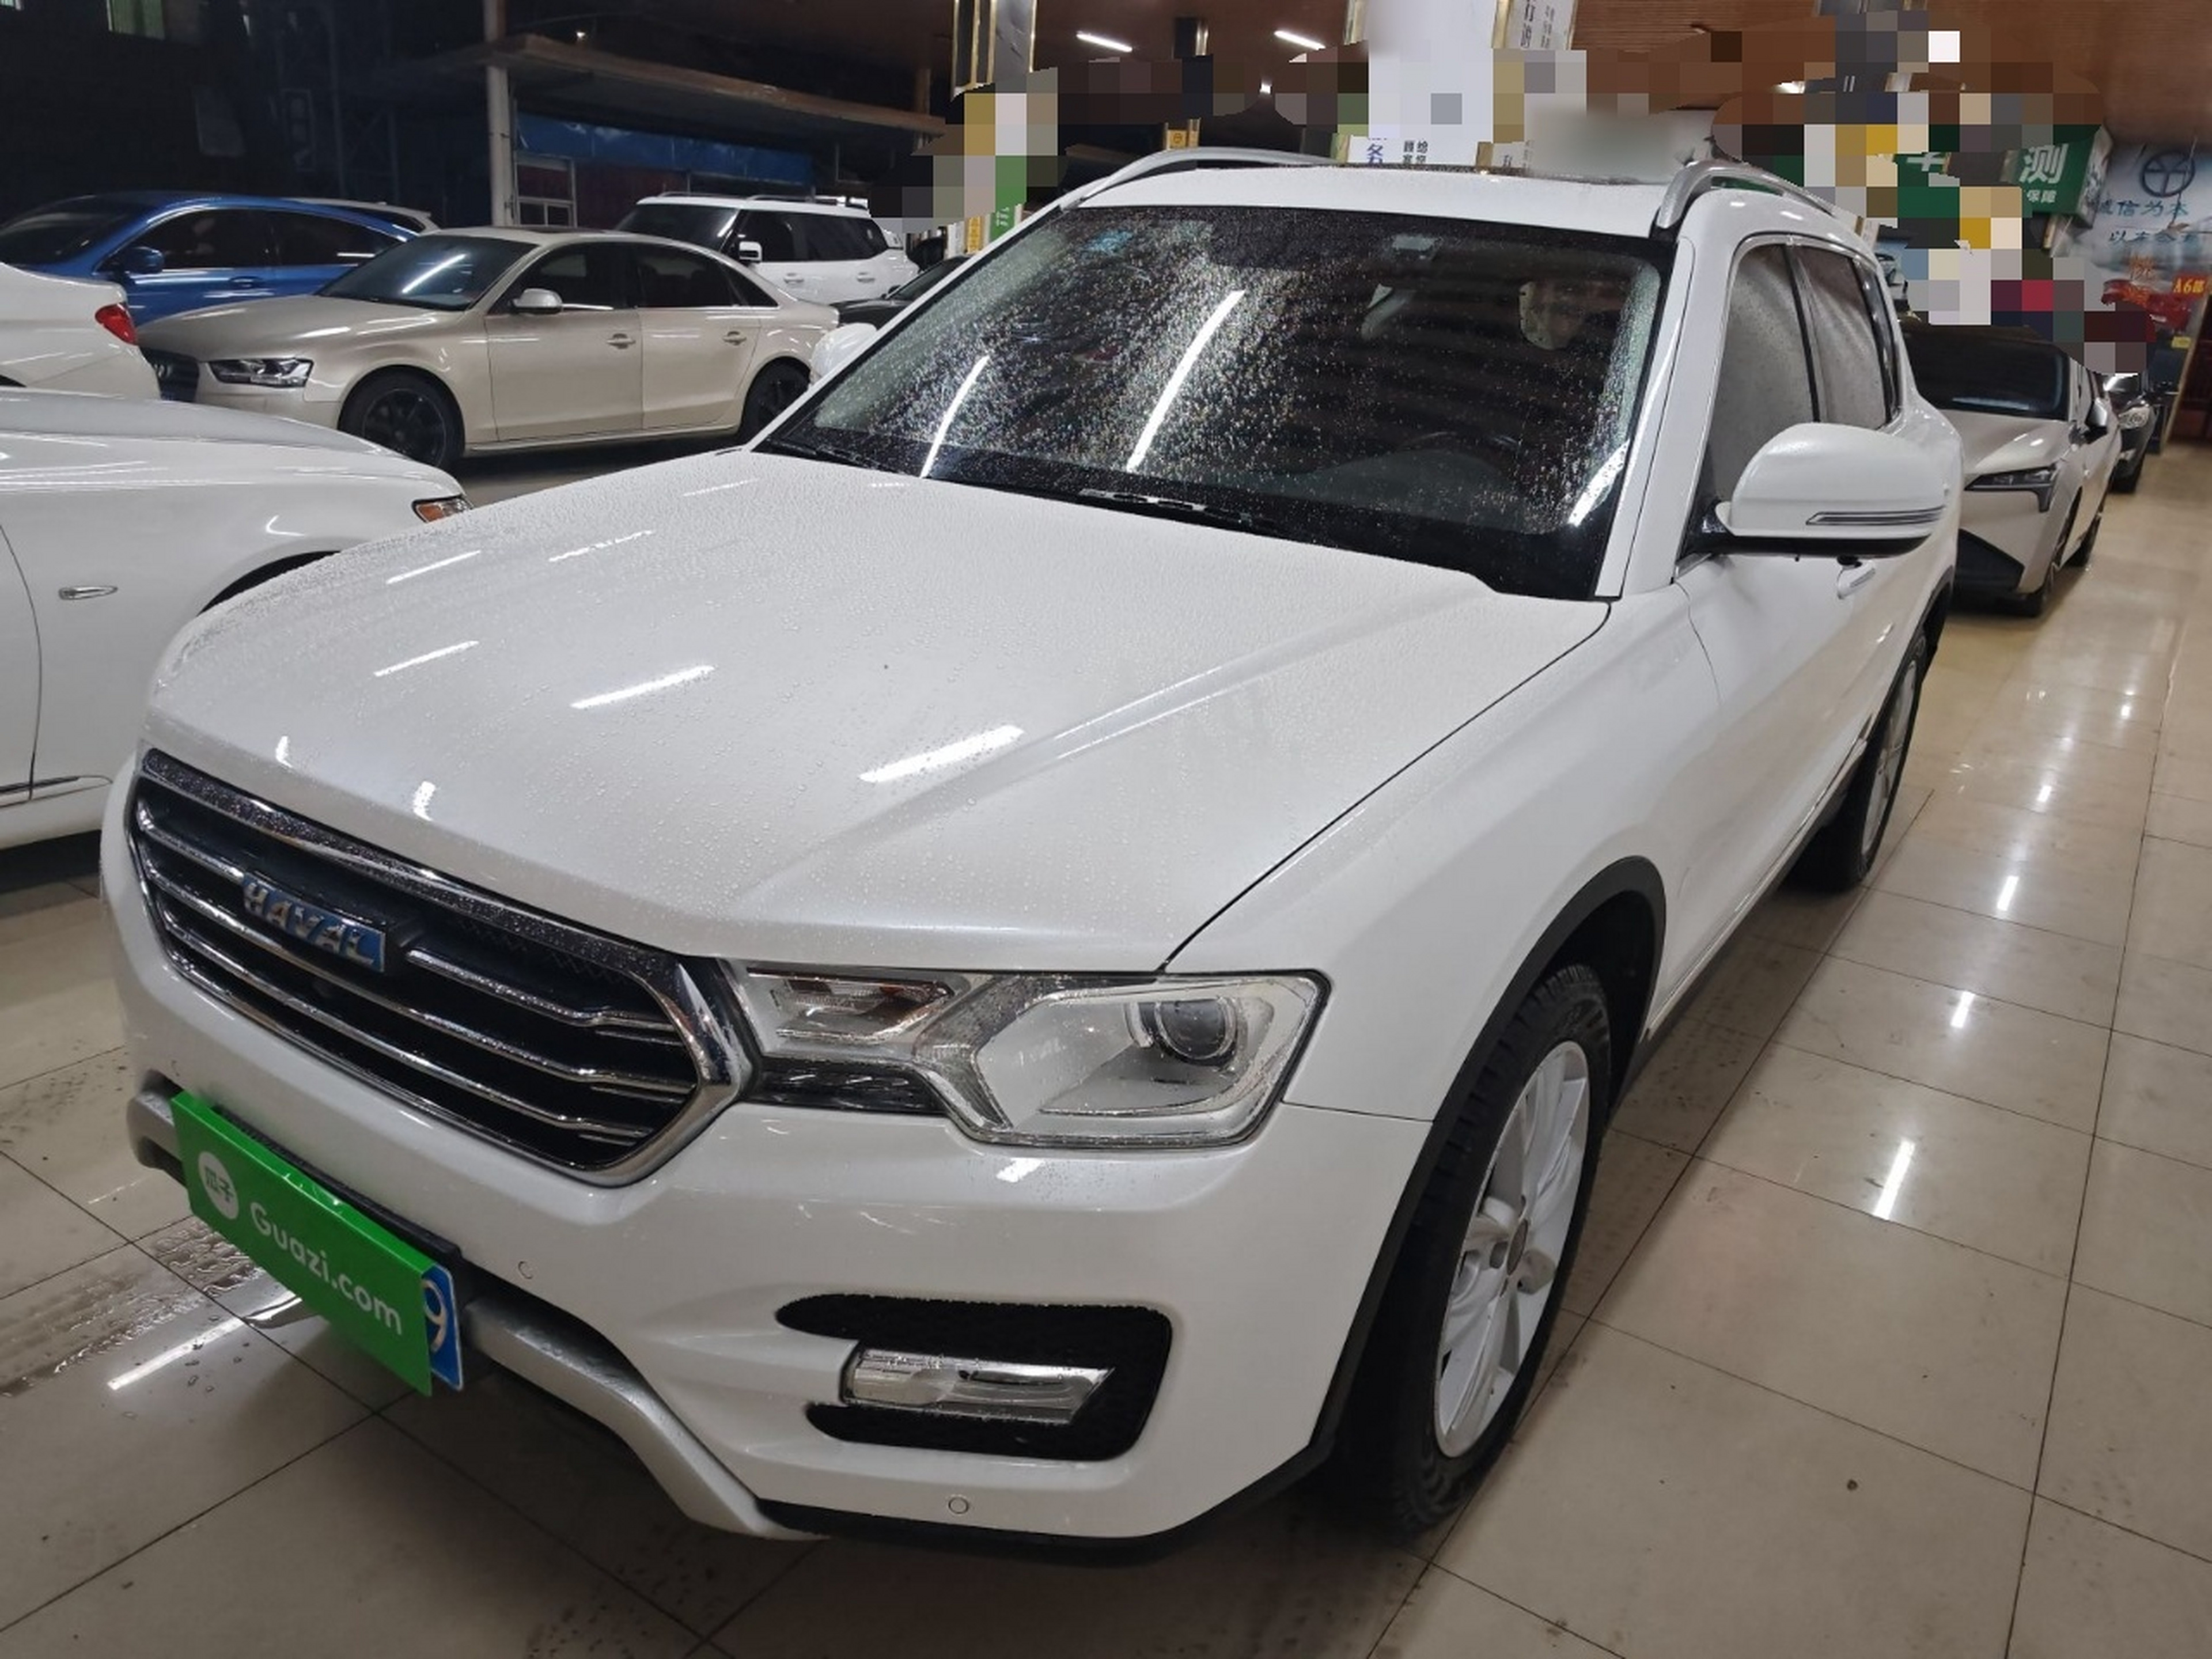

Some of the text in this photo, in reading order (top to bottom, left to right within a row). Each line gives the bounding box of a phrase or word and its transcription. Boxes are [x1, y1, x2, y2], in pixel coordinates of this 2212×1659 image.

[2019, 143, 2069, 184] 测
[243, 881, 375, 967] HAVAL
[250, 1202, 402, 1336] Guazi.com
[422, 1279, 448, 1353] 9
